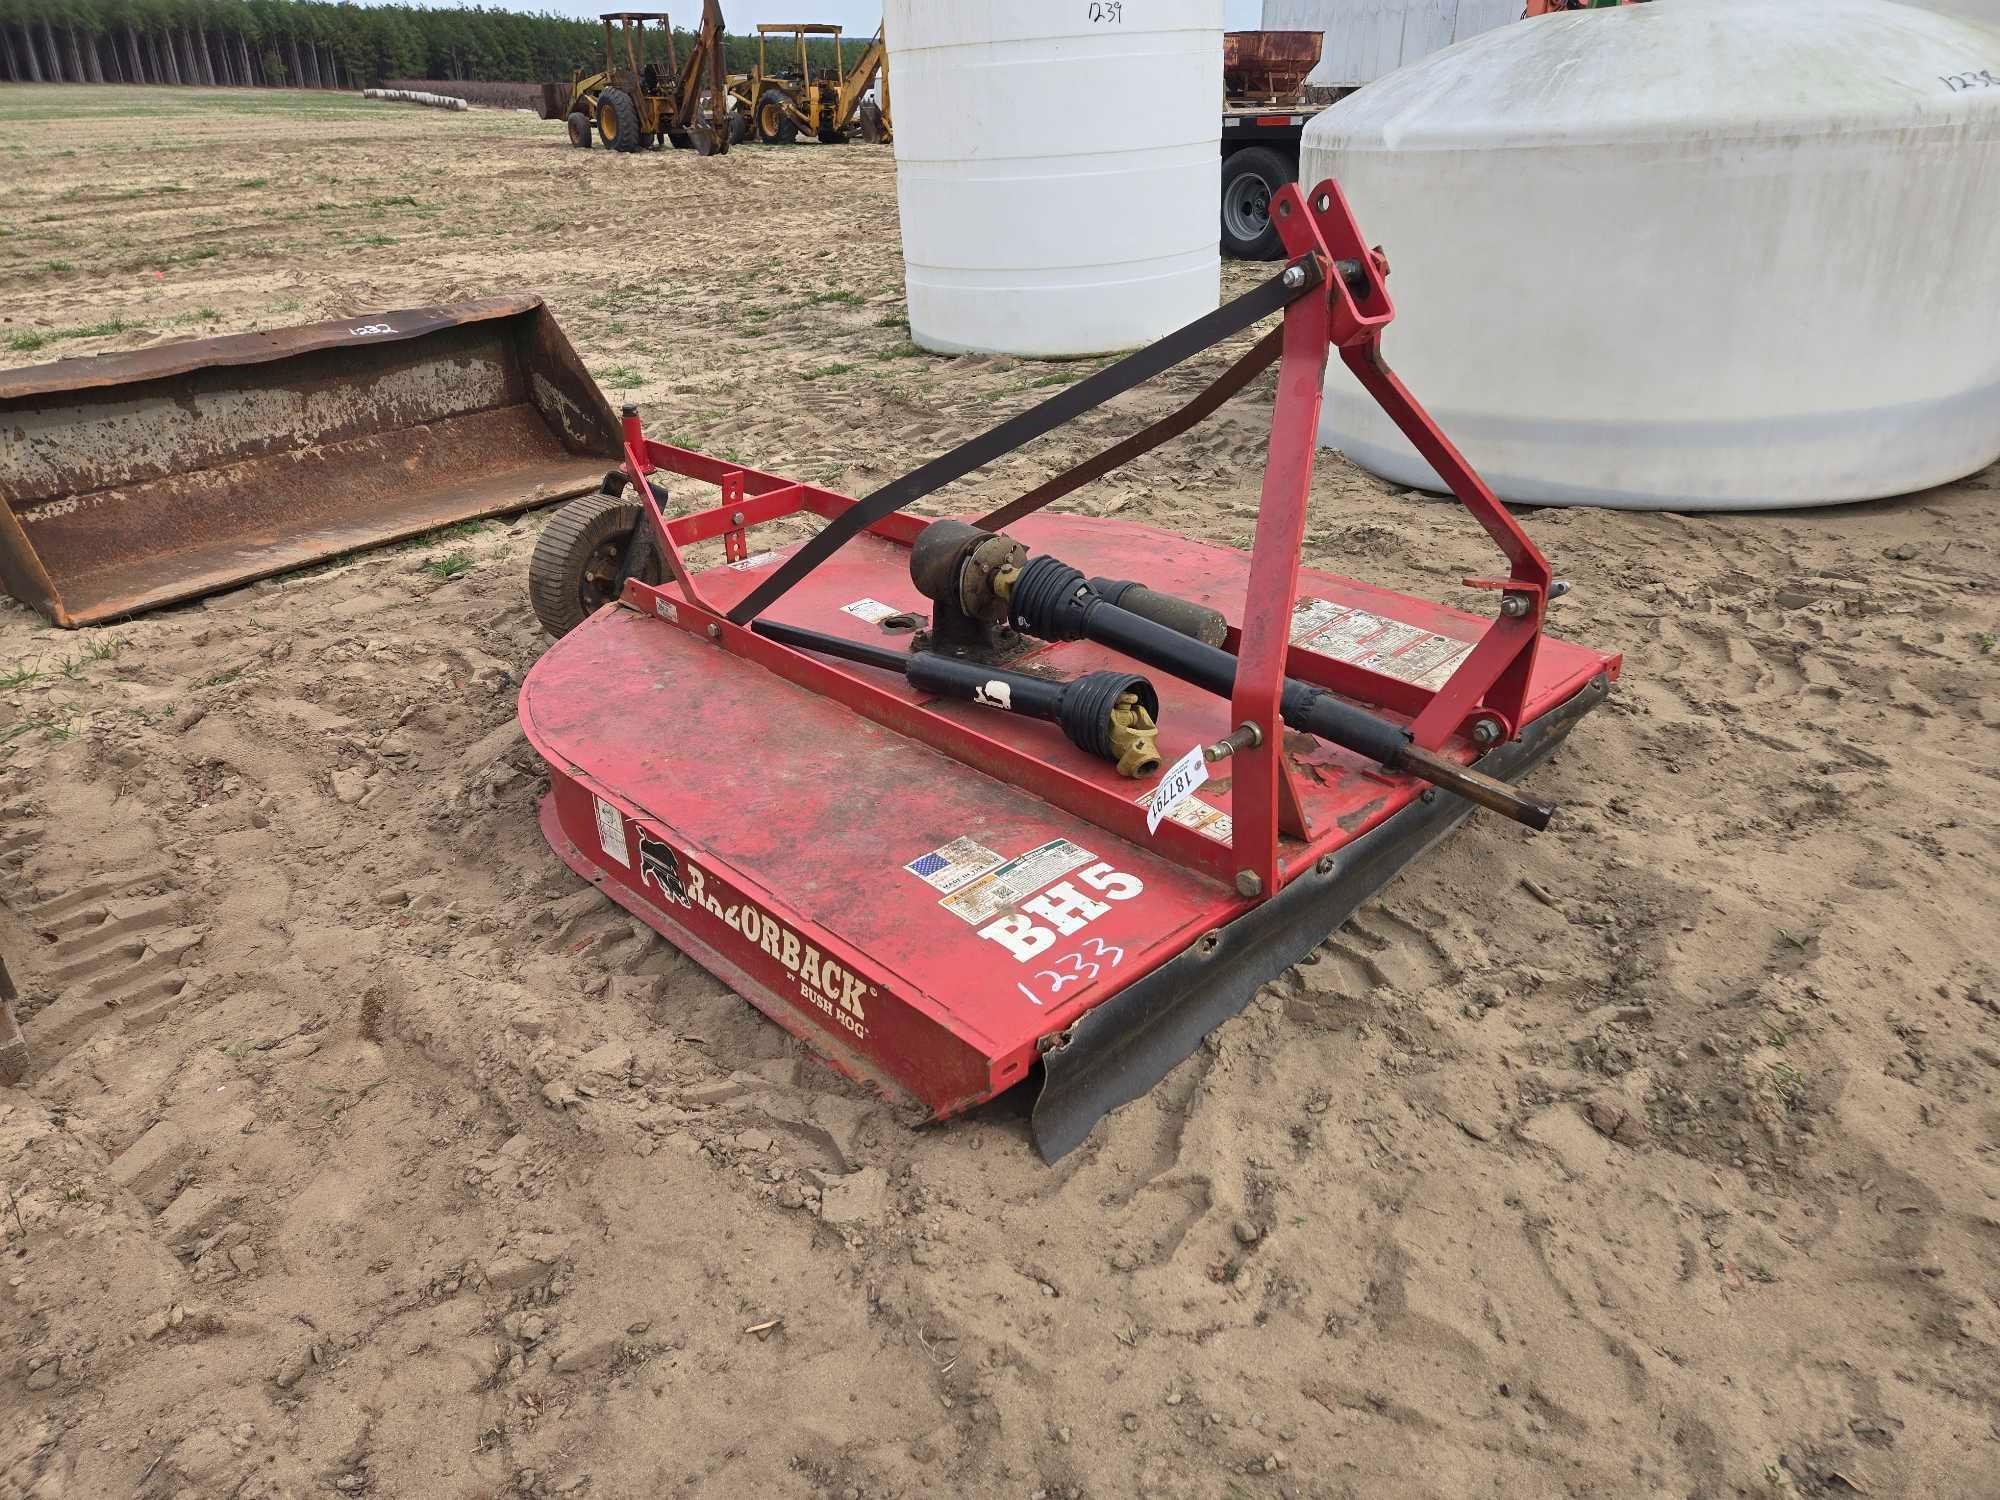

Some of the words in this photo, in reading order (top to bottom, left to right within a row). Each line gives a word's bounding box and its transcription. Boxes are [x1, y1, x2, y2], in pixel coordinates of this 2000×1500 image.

[1088, 1, 1122, 24] 1239
[1152, 771, 1192, 819] 187791
[1017, 938, 1124, 1005] 1233
[800, 981, 833, 1017] BUSH
[835, 1007, 865, 1040] HOG
